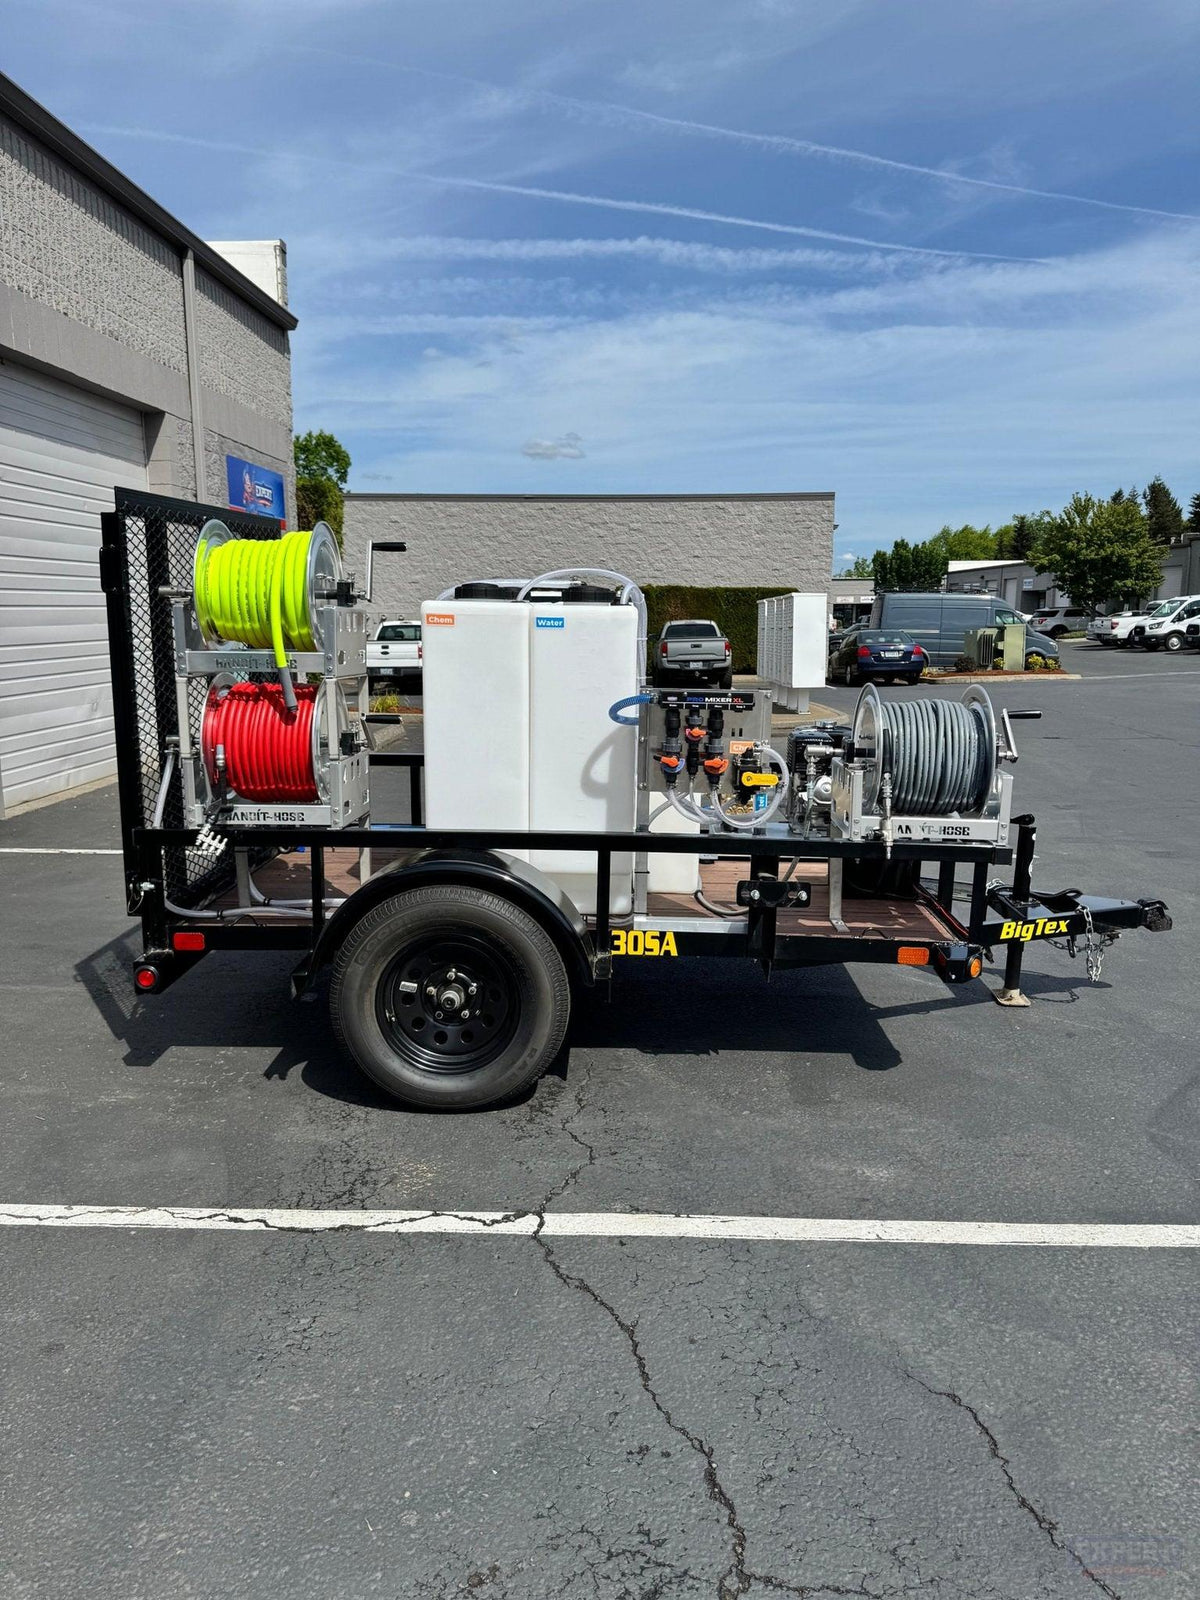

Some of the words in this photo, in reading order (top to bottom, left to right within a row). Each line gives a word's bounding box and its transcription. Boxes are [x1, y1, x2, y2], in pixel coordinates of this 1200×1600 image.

[428, 616, 454, 625] Chem
[537, 618, 564, 628] Water
[1000, 917, 1071, 942] BigTex
